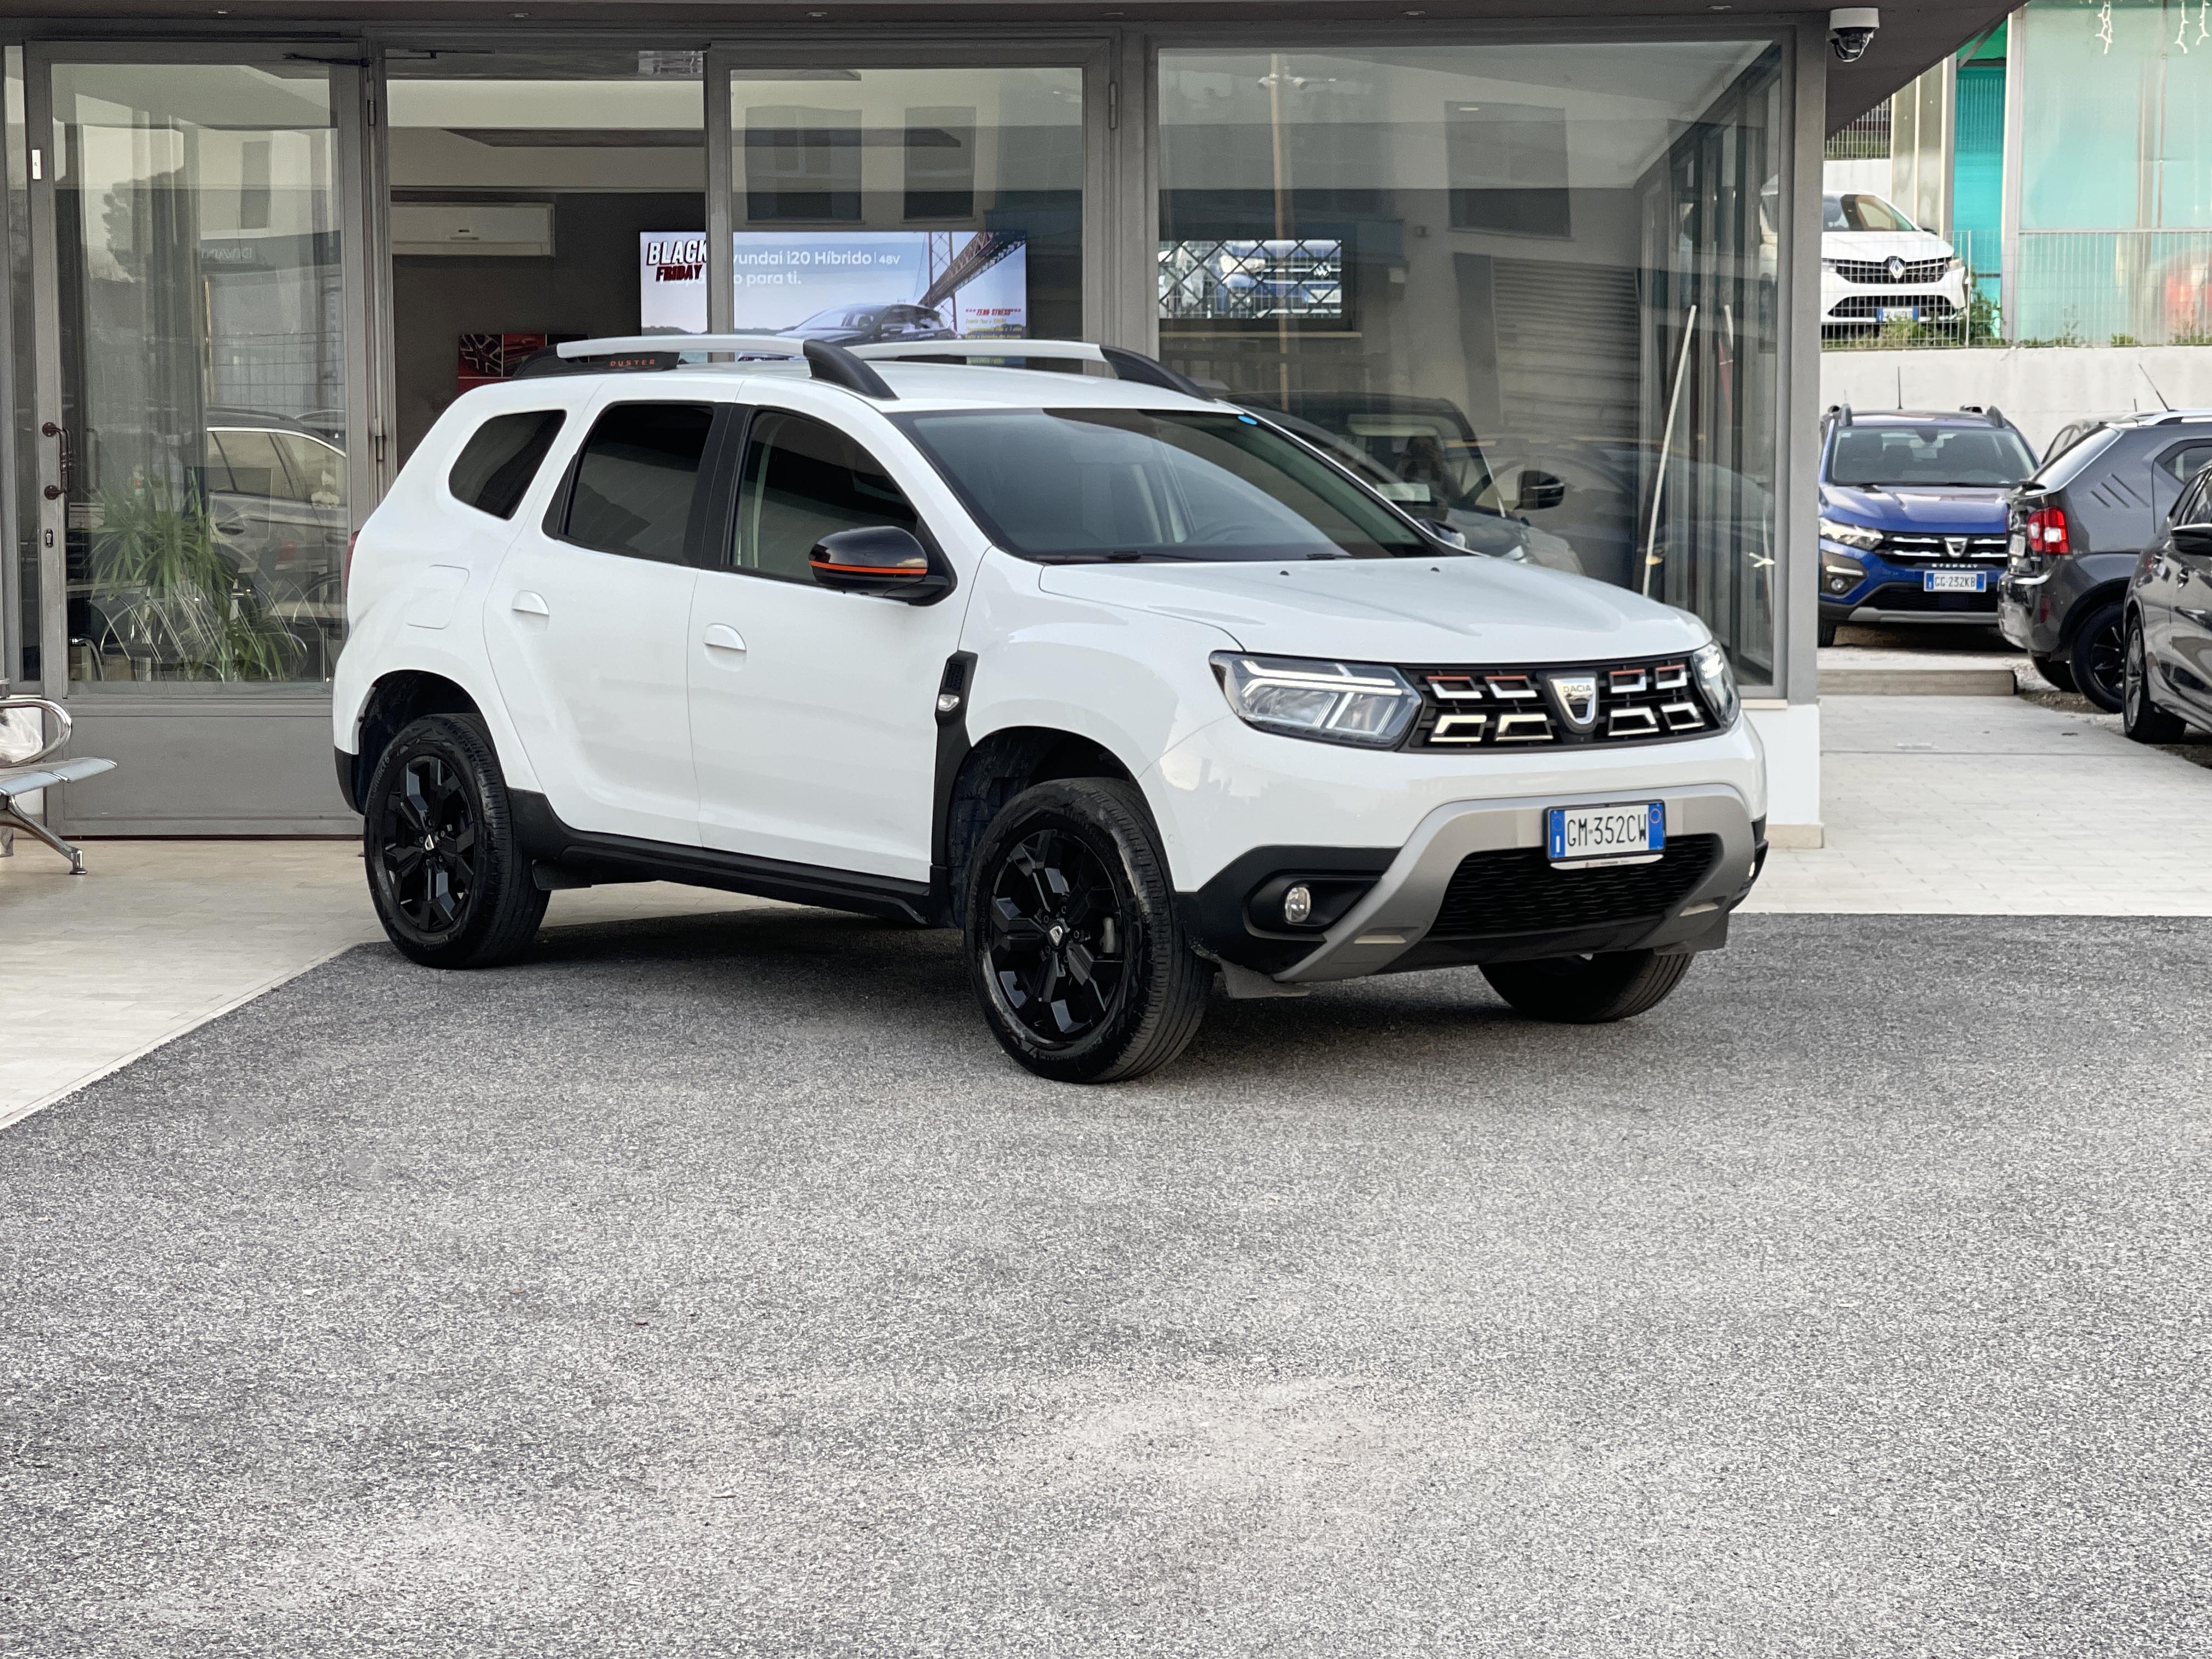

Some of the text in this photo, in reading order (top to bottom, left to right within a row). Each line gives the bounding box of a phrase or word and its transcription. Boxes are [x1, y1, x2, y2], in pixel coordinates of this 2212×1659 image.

[646, 240, 707, 266] BLACK
[733, 250, 783, 265] yundai
[787, 251, 810, 264] i20
[815, 250, 872, 265] Híbrido
[656, 264, 703, 282] FRIDAY
[747, 273, 783, 287] para
[787, 270, 802, 284] ti.
[1562, 684, 1592, 693] DACIA
